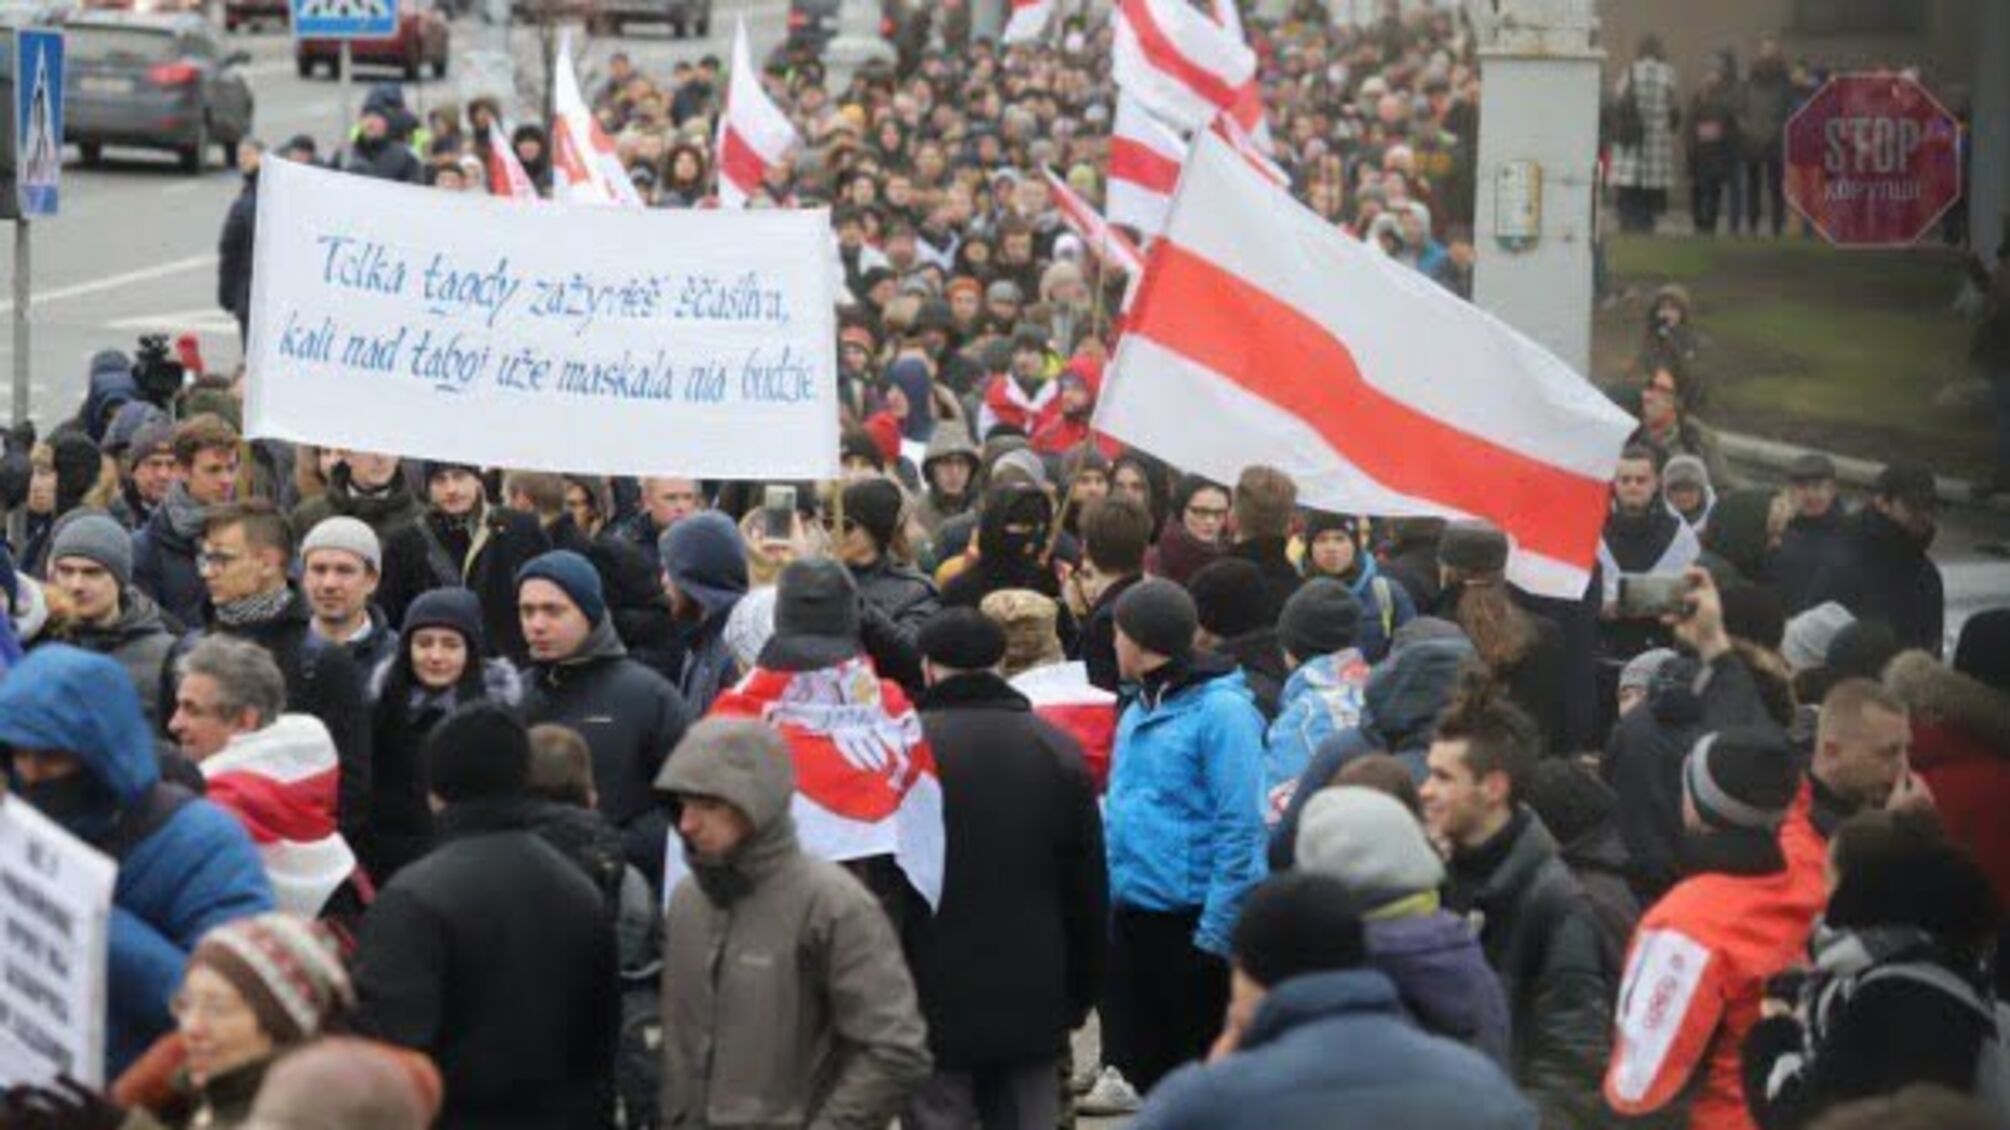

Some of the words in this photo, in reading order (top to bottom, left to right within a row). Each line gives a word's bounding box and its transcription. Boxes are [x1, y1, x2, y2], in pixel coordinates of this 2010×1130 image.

[316, 235, 406, 294] Tolka
[278, 308, 335, 363] kali
[342, 325, 407, 373] nad
[556, 349, 673, 398] maskala
